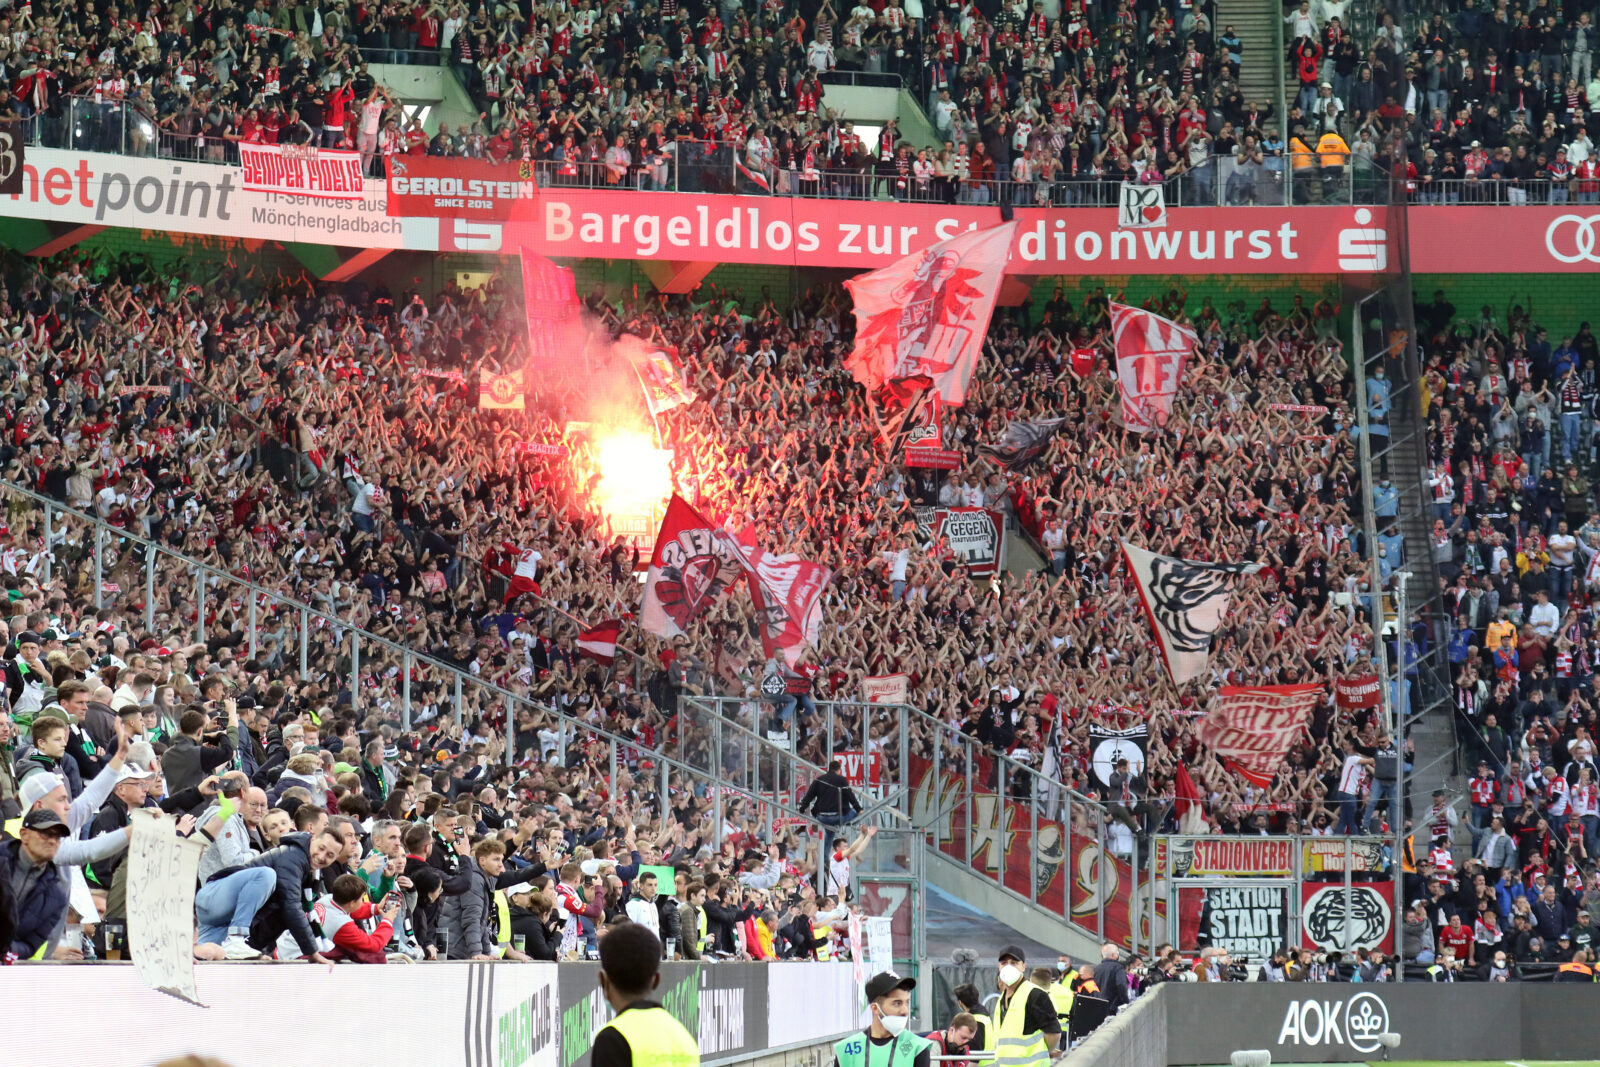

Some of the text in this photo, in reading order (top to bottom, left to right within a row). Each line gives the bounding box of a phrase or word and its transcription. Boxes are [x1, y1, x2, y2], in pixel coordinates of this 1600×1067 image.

[241, 149, 304, 188] SEMPER
[391, 176, 534, 199] GEROLSTEIN
[358, 199, 387, 211] aus
[434, 198, 493, 209] SINCE 2012
[252, 207, 402, 234] Mönchengladbach
[545, 201, 1299, 262] Bargeldlos zur Sdionwurst
[950, 521, 989, 536] GEGEN
[1193, 840, 1293, 871] STADIONVERB
[1311, 840, 1345, 856] Junge
[1209, 887, 1282, 909] SEKTION
[1210, 908, 1282, 938] STADT
[1211, 937, 1282, 959] VERBOT
[1277, 999, 1345, 1046] AOK
[844, 1041, 862, 1056] 45
